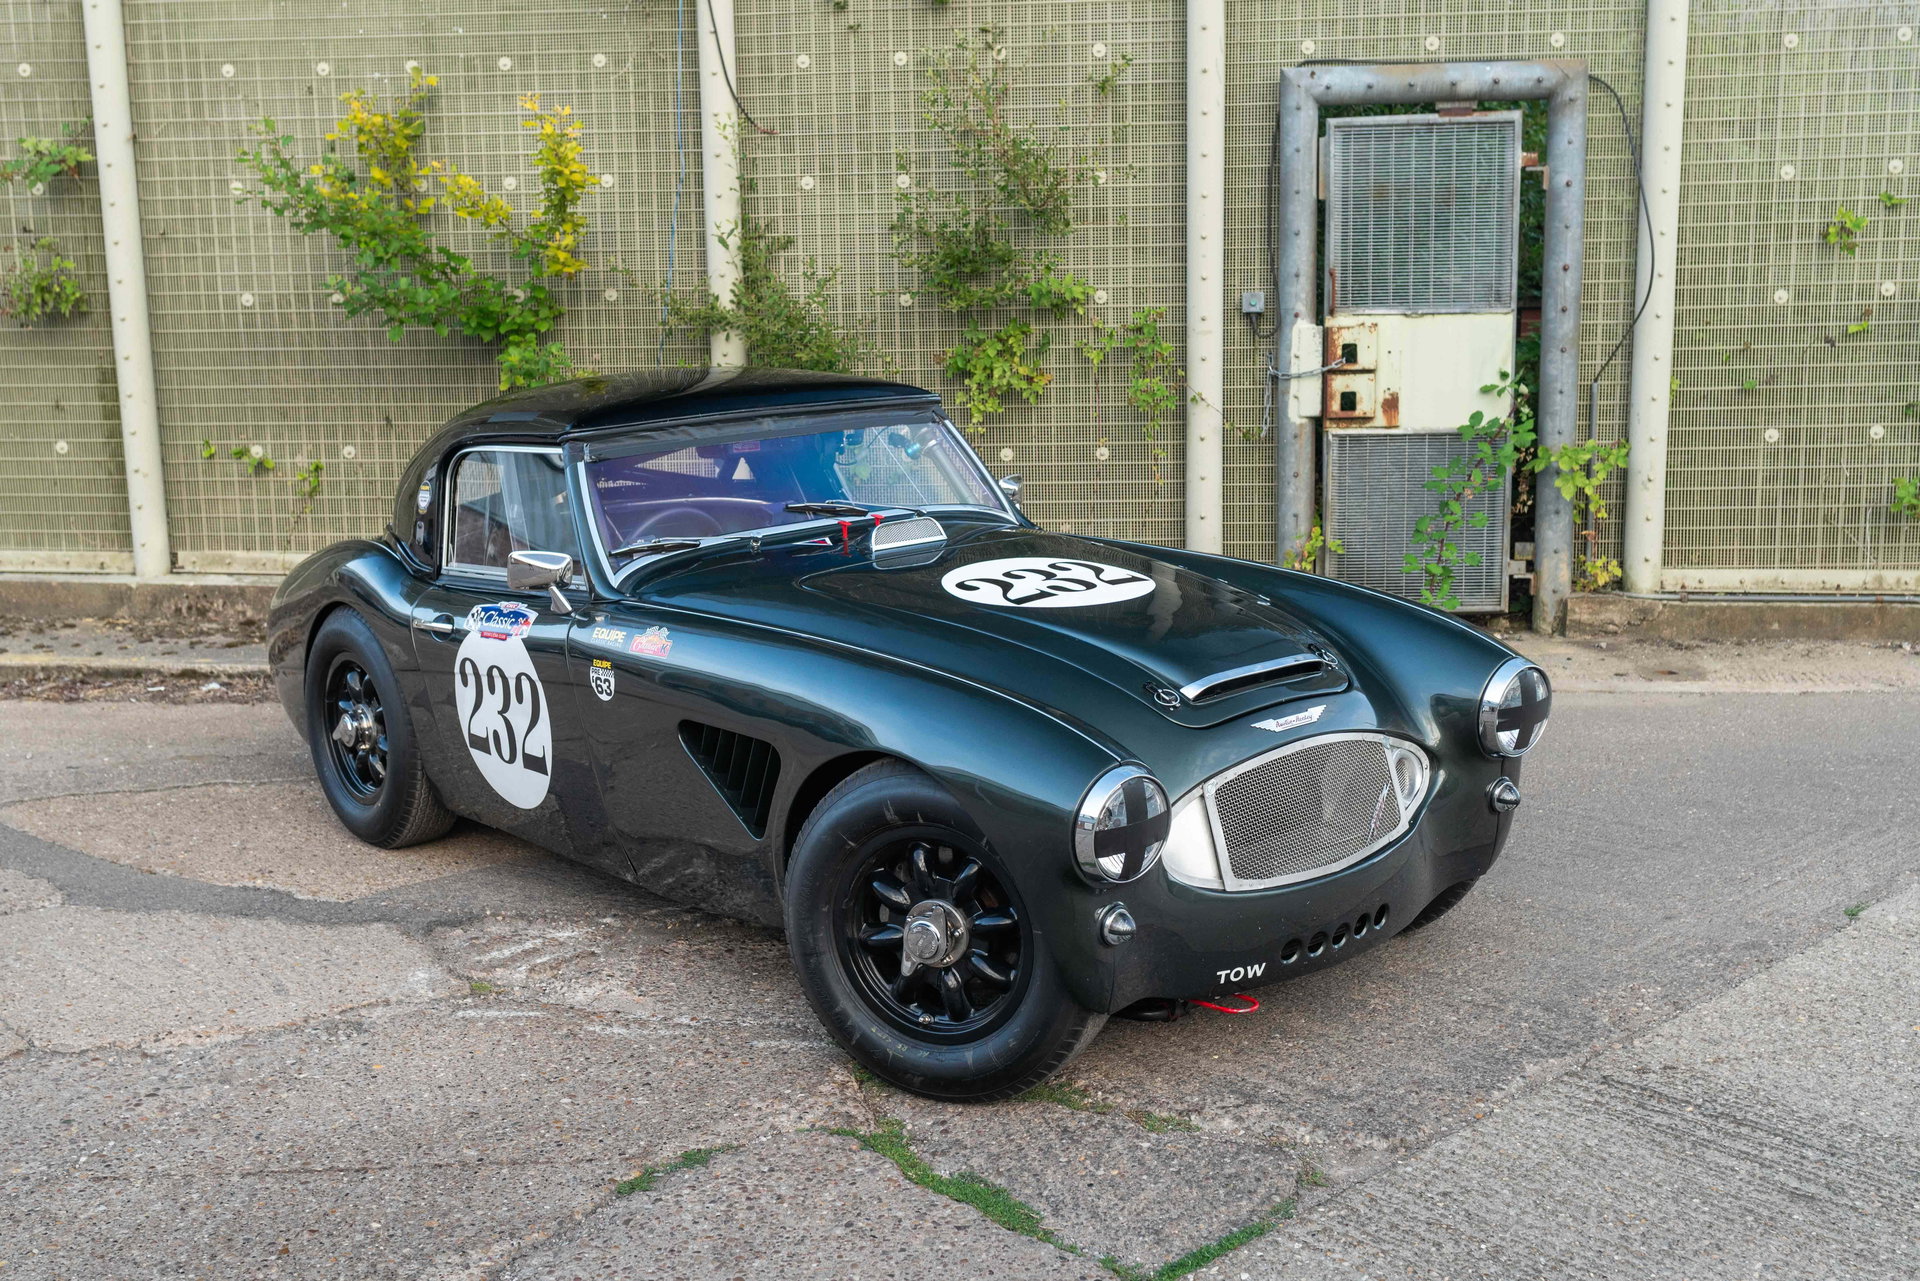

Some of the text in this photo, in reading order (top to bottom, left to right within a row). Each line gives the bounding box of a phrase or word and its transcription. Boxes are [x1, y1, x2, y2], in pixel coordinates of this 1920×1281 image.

[955, 561, 1150, 605] 232
[483, 611, 516, 629] Classic
[592, 627, 627, 643] EQUIPE
[593, 659, 612, 669] EQUIPE
[459, 657, 549, 776] 232
[1216, 962, 1267, 984] TOW
